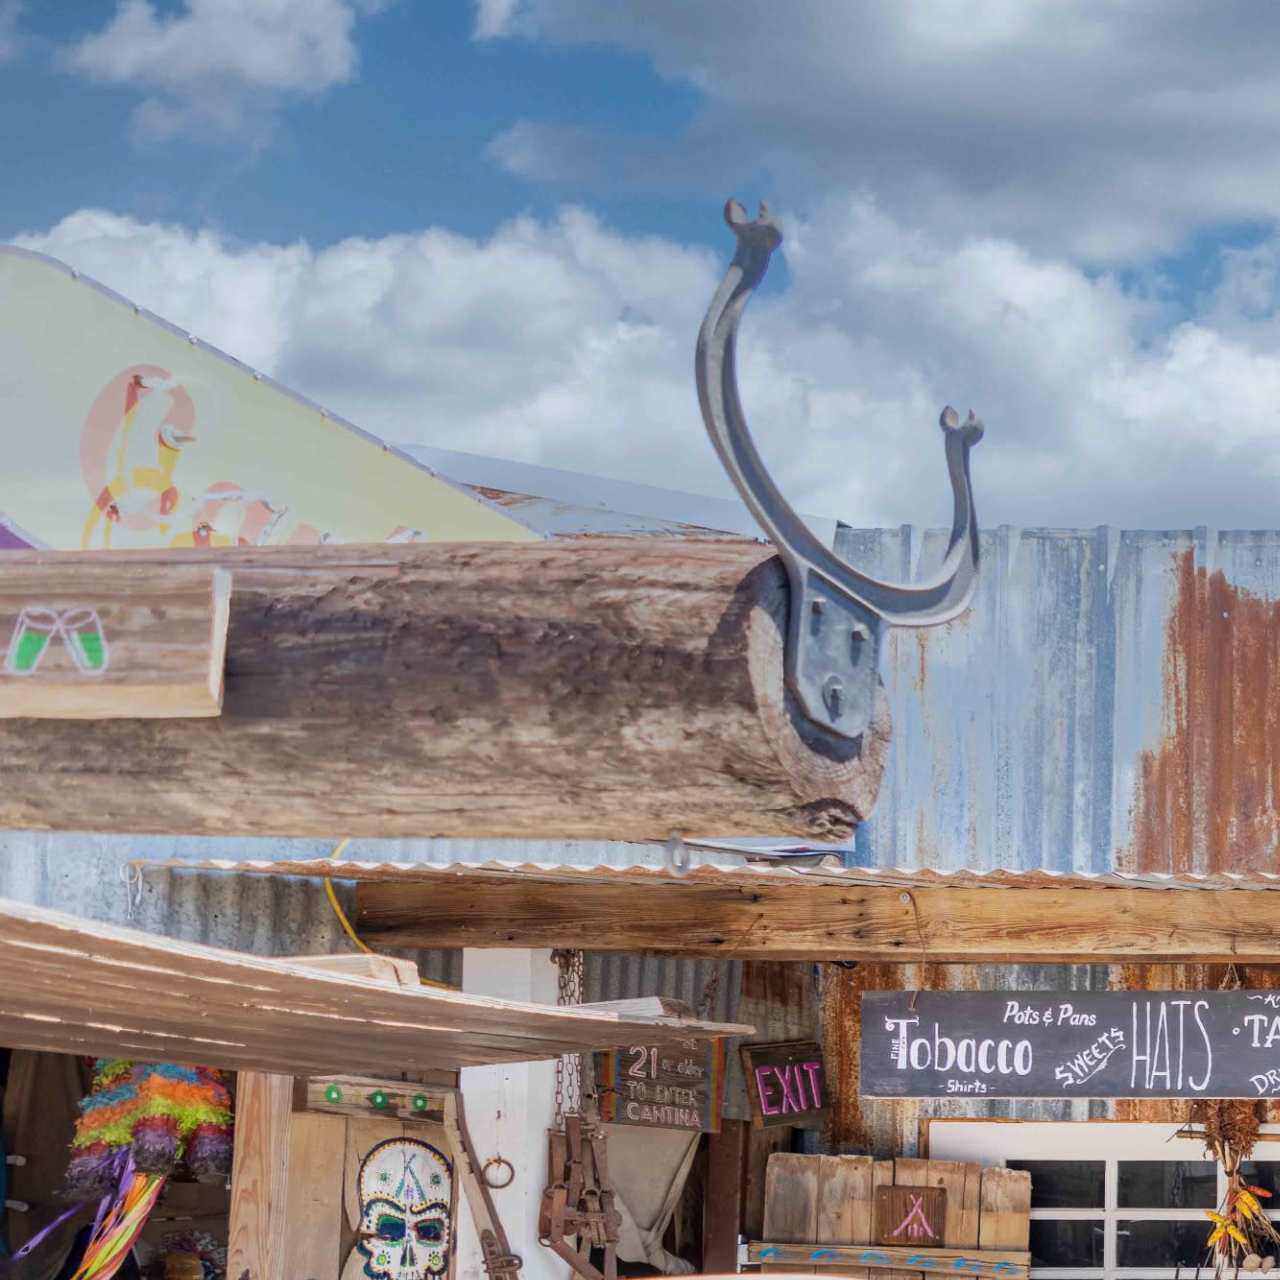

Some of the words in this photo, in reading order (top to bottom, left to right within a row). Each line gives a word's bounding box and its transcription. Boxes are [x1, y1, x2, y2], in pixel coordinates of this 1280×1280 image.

[1003, 1000, 1040, 1025] Pots
[1042, 1007, 1054, 1027] &
[1057, 1003, 1097, 1026] Pans
[628, 1045, 658, 1080] 21
[884, 1016, 1033, 1076] Tobacco
[1055, 1027, 1124, 1089] SWEETS
[1130, 1000, 1212, 1091] HATS
[755, 1062, 821, 1116] EXIT
[946, 1079, 988, 1094] Shirts
